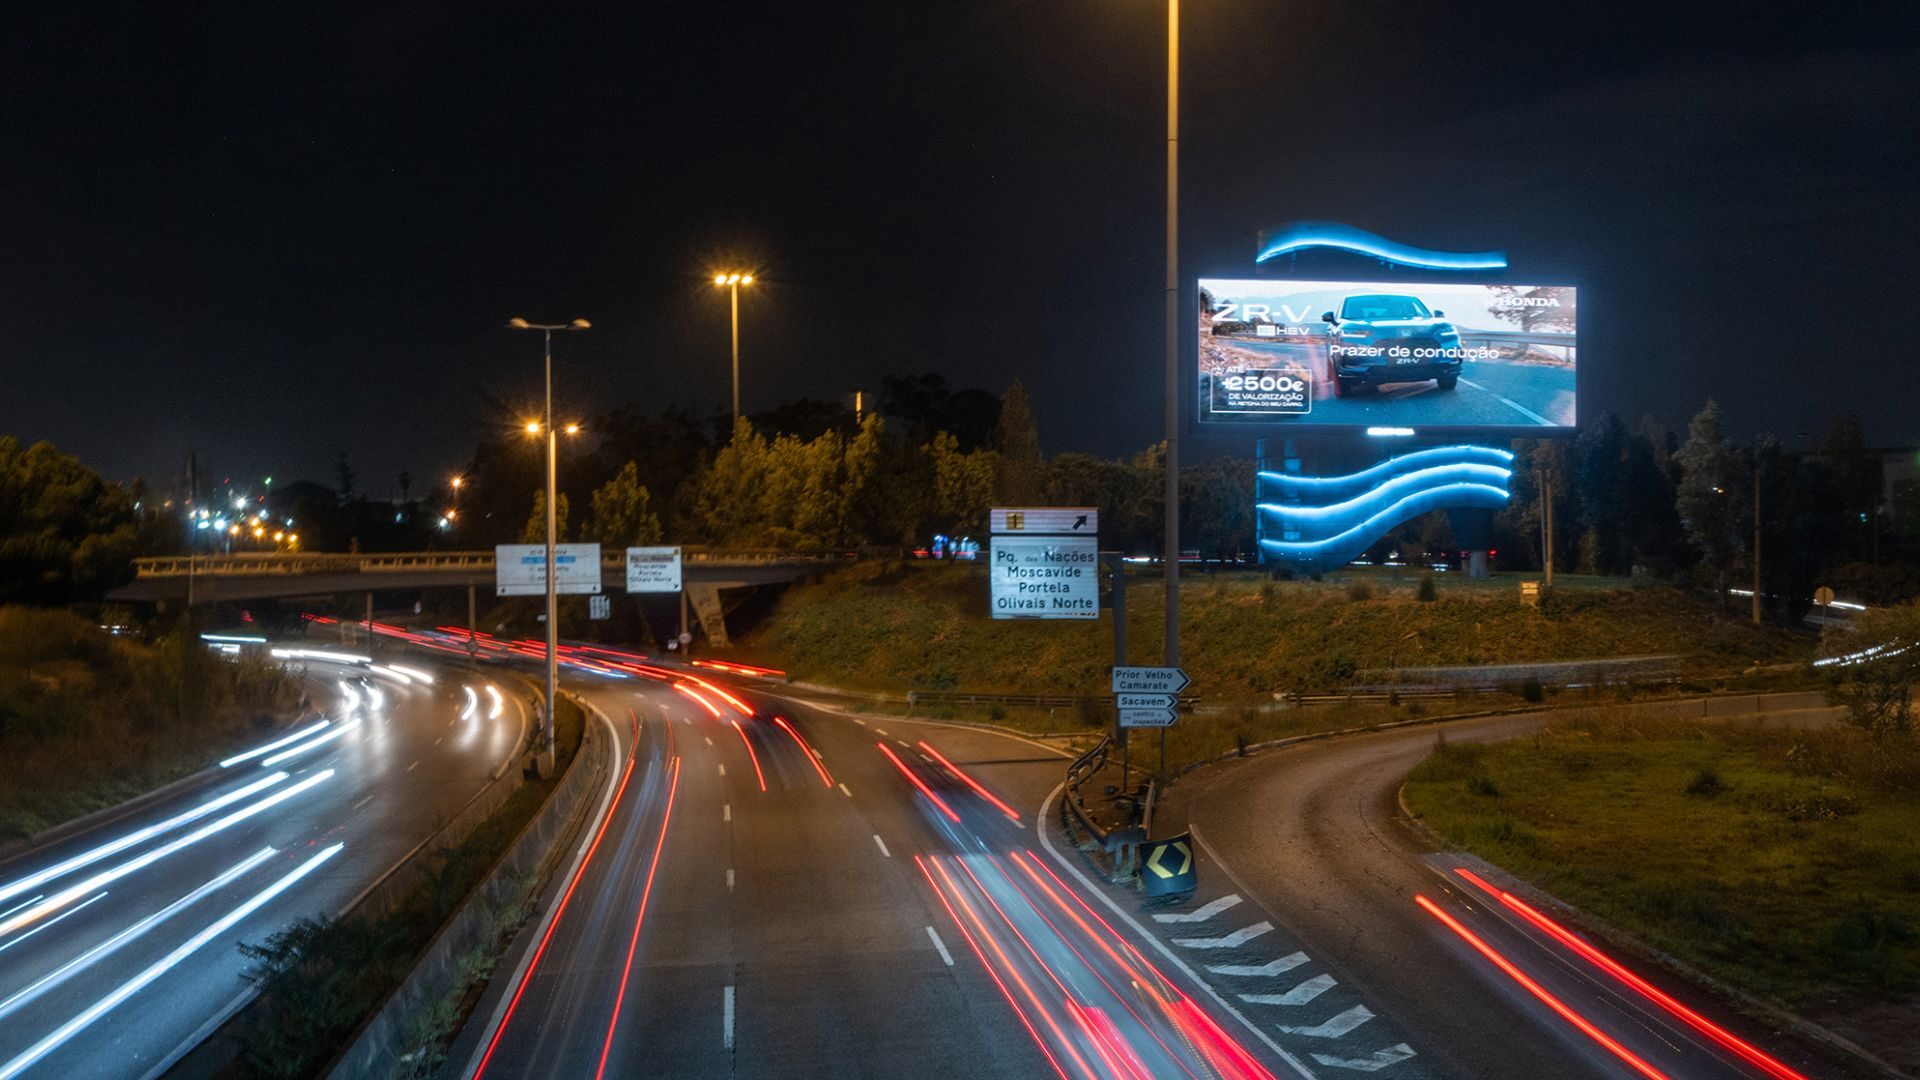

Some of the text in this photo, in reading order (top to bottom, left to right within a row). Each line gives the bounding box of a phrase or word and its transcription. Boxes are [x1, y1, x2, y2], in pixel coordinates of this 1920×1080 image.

[1500, 297, 1561, 307] HONDA
[1211, 303, 1313, 323] ZR-V
[1329, 344, 1500, 362] Prazer de condução
[1228, 392, 1304, 402] DE VALORIZAÇÃO
[996, 551, 1018, 564] Pq.
[1044, 550, 1095, 565] Nações
[1007, 566, 1082, 577] Moscavide
[1018, 582, 1070, 593] Portela
[997, 597, 1094, 609] Olivais Norte
[1115, 670, 1173, 679] Prior Velho
[1119, 681, 1169, 690] Camarate
[1121, 697, 1166, 706] Sacavém
